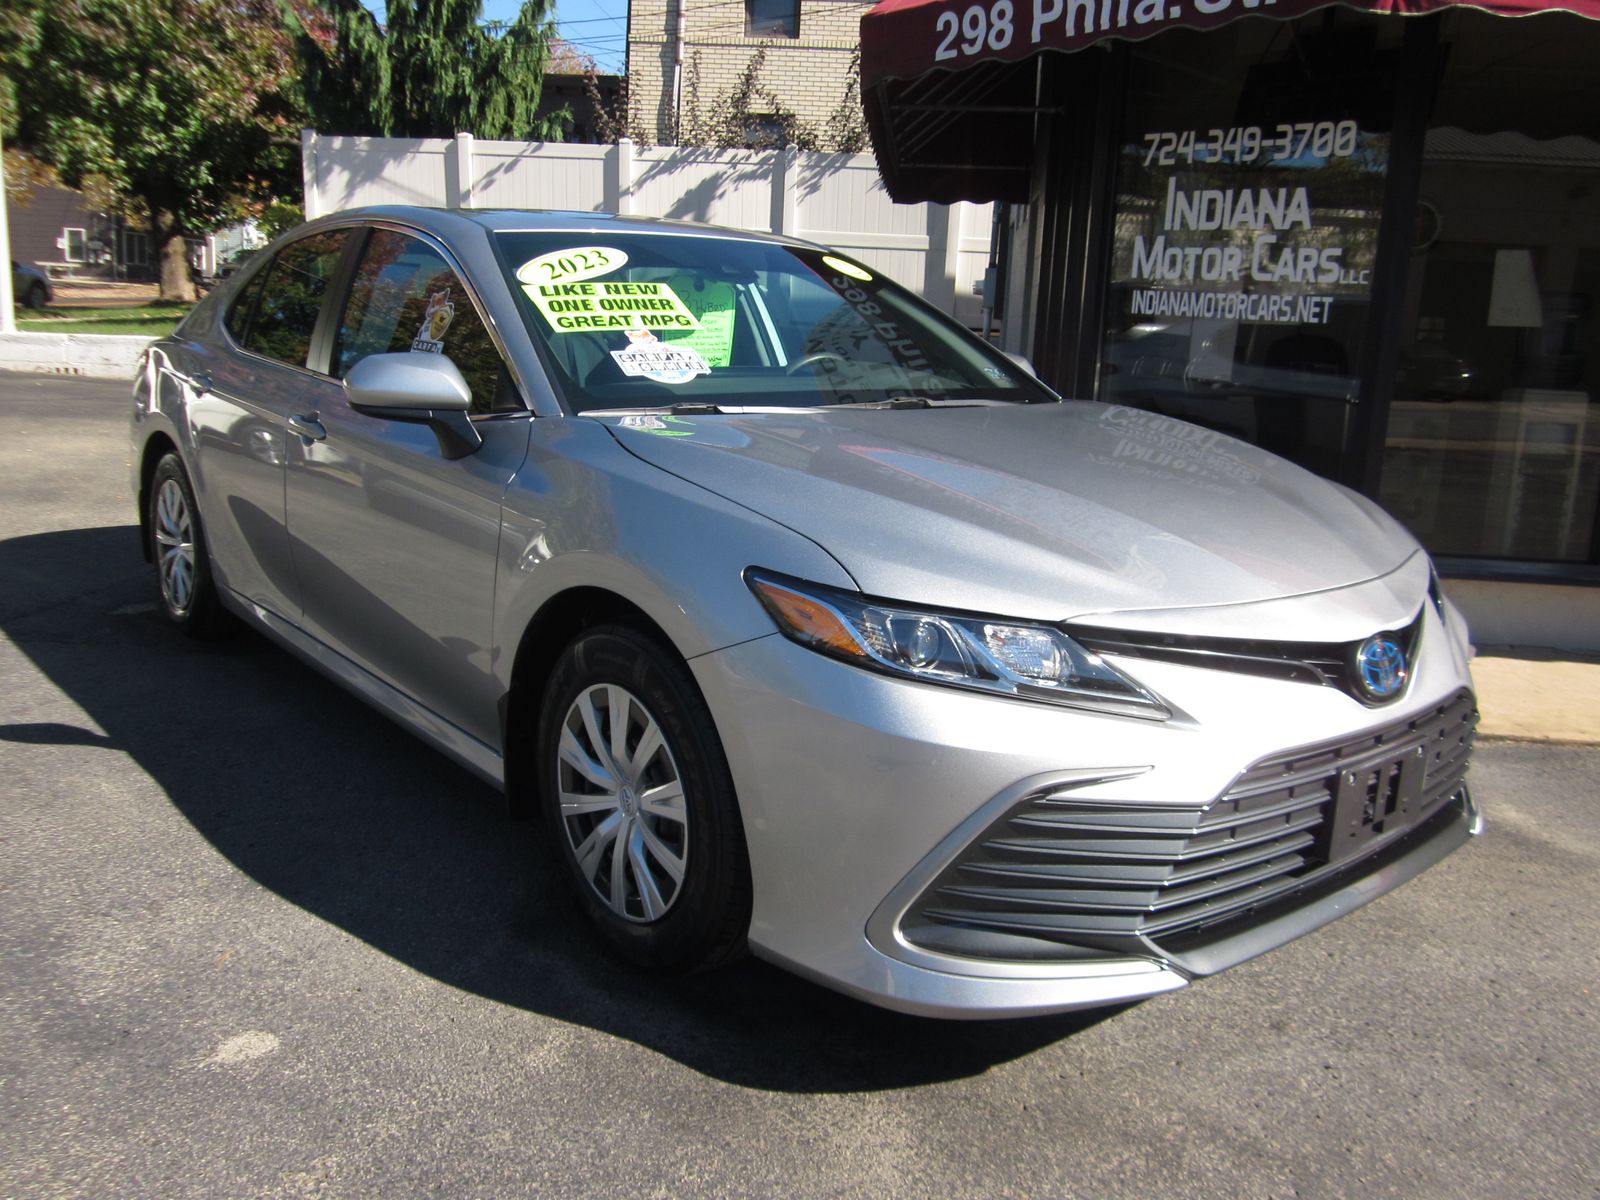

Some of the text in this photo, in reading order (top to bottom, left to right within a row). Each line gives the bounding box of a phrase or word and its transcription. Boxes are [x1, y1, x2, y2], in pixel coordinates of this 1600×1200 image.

[935, 0, 1182, 62] 298 Phila.
[1143, 120, 1358, 167] 724-349-3700
[1164, 176, 1312, 231] INDIANA
[540, 250, 610, 281] 2023
[1131, 234, 1371, 285] MOTOR CARS LLC
[538, 284, 659, 297] LIKE NEW
[547, 300, 594, 313] ONE
[600, 298, 675, 312] OWNER
[1131, 289, 1334, 324] INDIANAMOTORCARS.NET
[556, 315, 633, 328] GREAT
[640, 314, 692, 327] MPG
